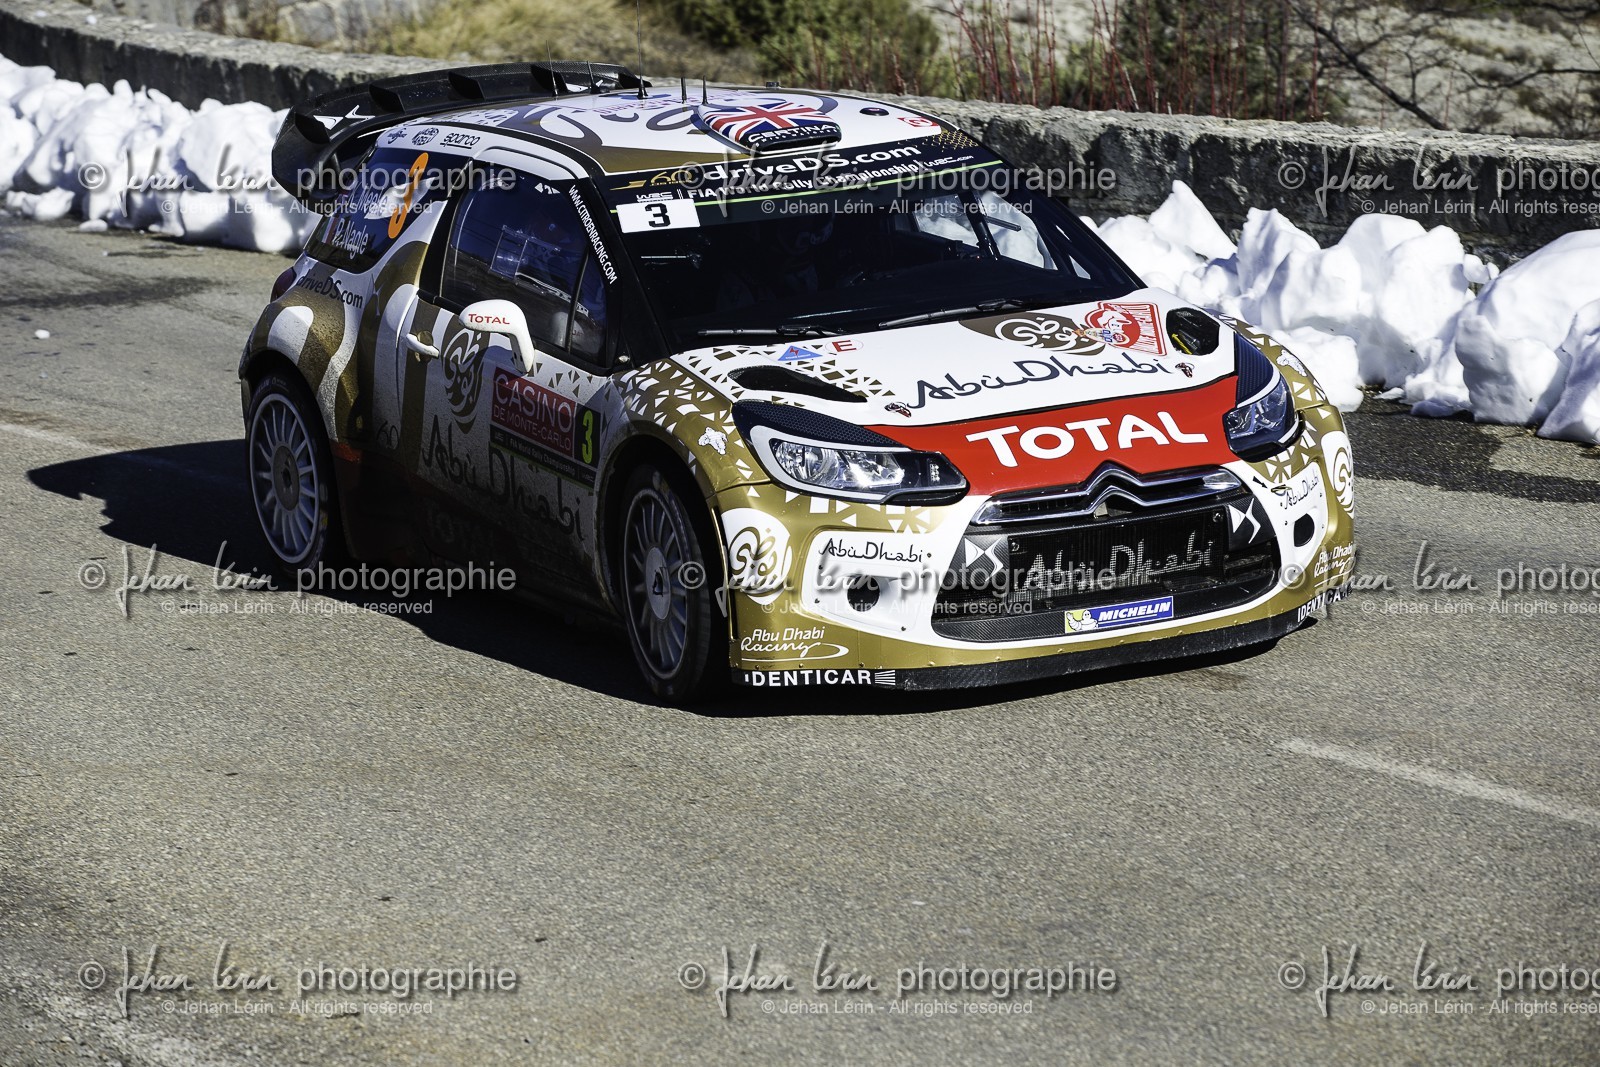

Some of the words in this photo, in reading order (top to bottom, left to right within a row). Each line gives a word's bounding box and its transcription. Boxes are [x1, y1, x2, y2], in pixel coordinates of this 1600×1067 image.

[747, 124, 836, 143] CERTINA
[703, 145, 922, 180] driveDS.com
[387, 151, 429, 239] 3
[686, 188, 718, 199] FIA
[815, 163, 919, 186] Championship
[645, 202, 671, 228] 3
[468, 313, 510, 325] TOTAL
[832, 339, 857, 353] E
[495, 373, 573, 433] CASINO
[493, 404, 506, 421] DE
[507, 410, 572, 451] MONTE-CARLO
[582, 409, 594, 464] 3
[965, 411, 1209, 468] TOTAL
[1097, 600, 1172, 622] MICHELIN
[740, 637, 820, 658] Racing
[751, 628, 779, 642] Abu
[783, 626, 825, 641] Dhabi
